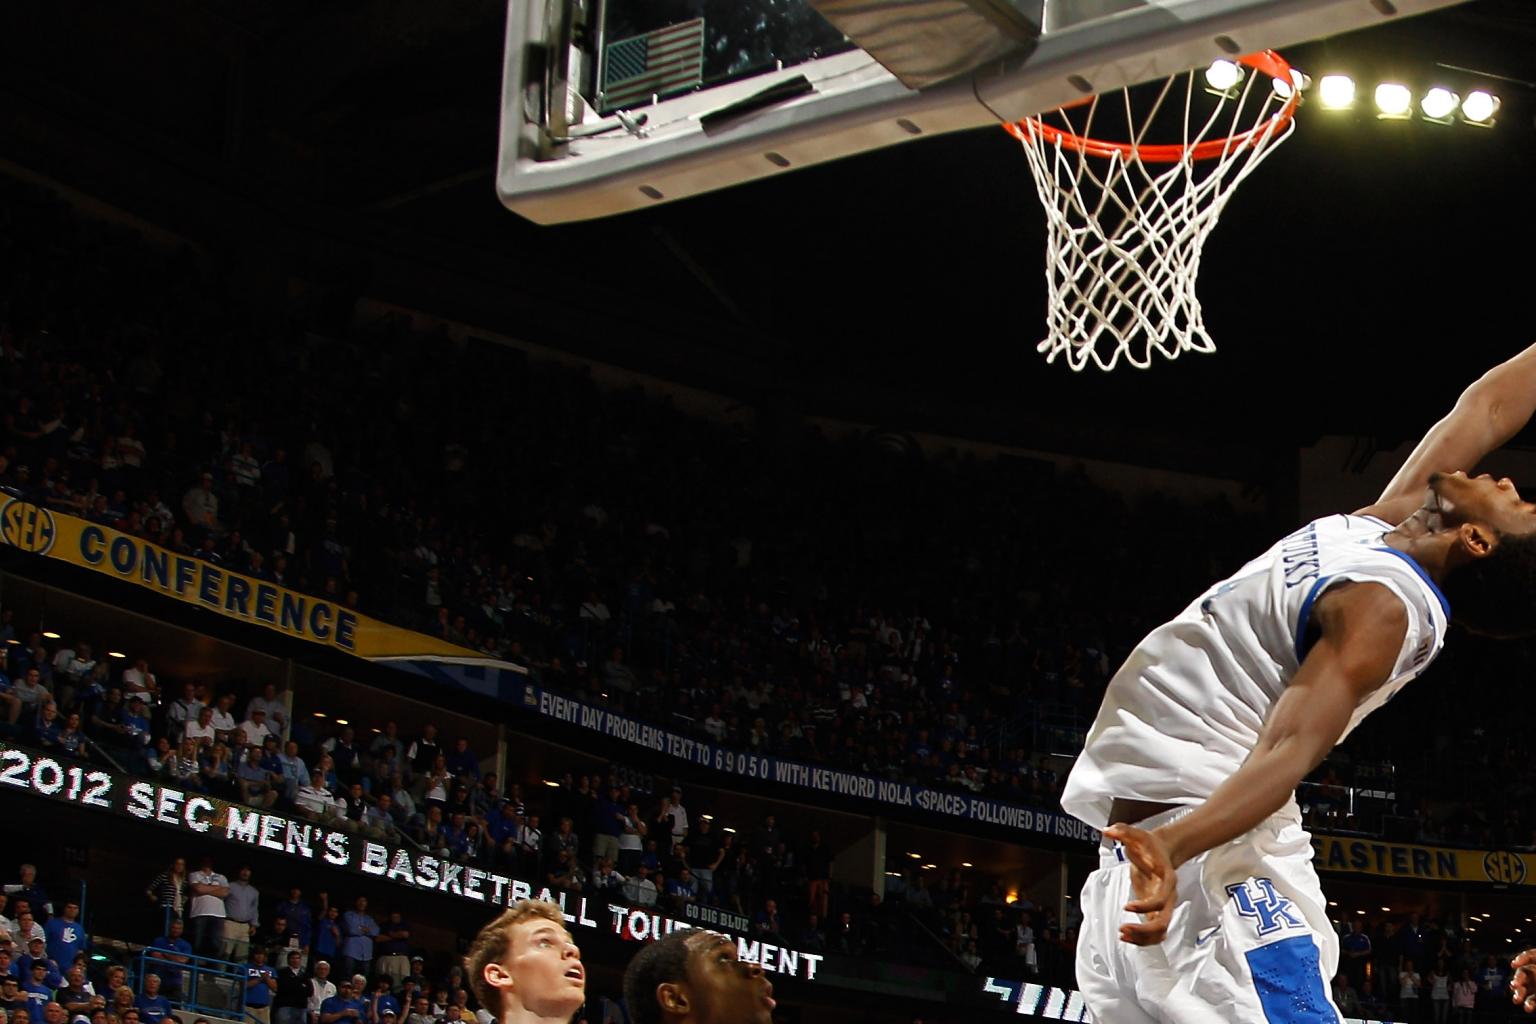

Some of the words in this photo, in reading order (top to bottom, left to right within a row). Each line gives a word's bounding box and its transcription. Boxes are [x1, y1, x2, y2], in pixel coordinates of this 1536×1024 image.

[2, 501, 55, 553] SEC
[79, 525, 358, 651] CONFERENCE
[539, 691, 580, 724] EVENT
[581, 704, 604, 731] DAY
[605, 713, 665, 752] PROBLEMS
[666, 731, 695, 761] TEXT
[695, 743, 711, 766] TO
[775, 759, 809, 787] WITH
[811, 768, 876, 799] KEYWORD
[878, 780, 912, 807] NOLA
[969, 801, 1033, 831] FOLLOWED
[1035, 812, 1052, 834] BY
[1054, 816, 1088, 841] ISSUE
[0, 749, 113, 808] 2012
[125, 781, 215, 833] SEC
[225, 805, 351, 866] MEN'S
[361, 838, 597, 928] BASKETBALL
[607, 903, 824, 981] TOUMENT
[1484, 850, 1527, 884] SEC
[685, 903, 699, 919] GO
[700, 907, 718, 924] BIG
[720, 912, 749, 932] BLUE
[1223, 875, 1306, 937] UK
